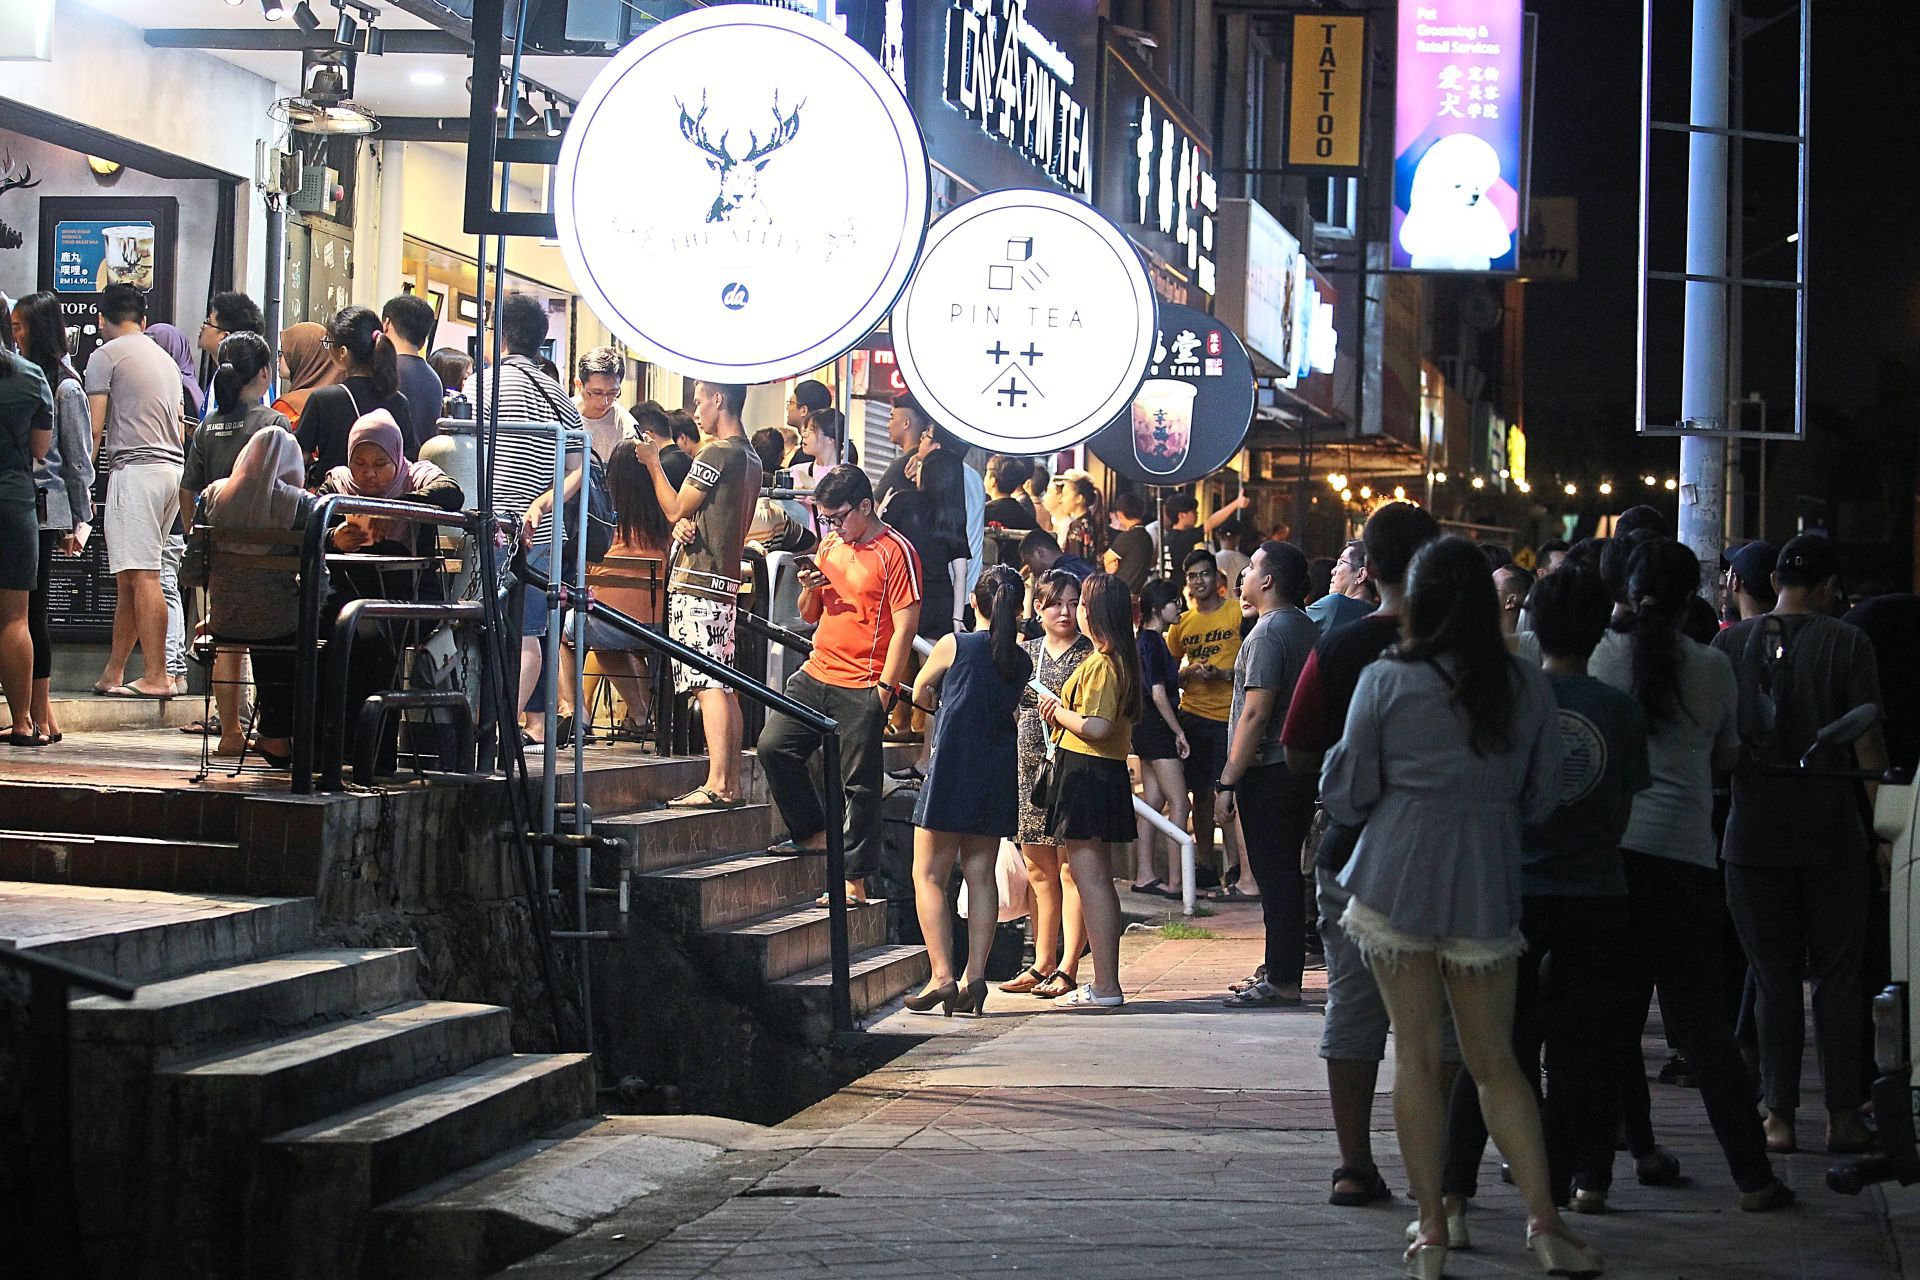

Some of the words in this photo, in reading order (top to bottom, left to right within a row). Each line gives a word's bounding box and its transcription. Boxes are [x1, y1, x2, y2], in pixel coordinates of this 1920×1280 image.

[1416, 6, 1438, 20] Pet
[1416, 24, 1477, 40] Grooming
[1477, 24, 1489, 38] &
[1416, 40, 1450, 53] Retail
[1451, 41, 1501, 54] Services
[1316, 24, 1337, 157] TATTOO
[1024, 56, 1056, 167] PIN
[1059, 91, 1092, 195] TEA
[60, 252, 81, 263] 鹿丸
[60, 277, 88, 285] RM14.90
[60, 303, 88, 315] TOP
[89, 303, 98, 315] 6
[950, 303, 1000, 324] PIN
[1028, 306, 1083, 329] TEA
[710, 577, 725, 590] NO
[1182, 634, 1202, 646] on
[1204, 628, 1233, 644] the
[1187, 643, 1222, 660] edge
